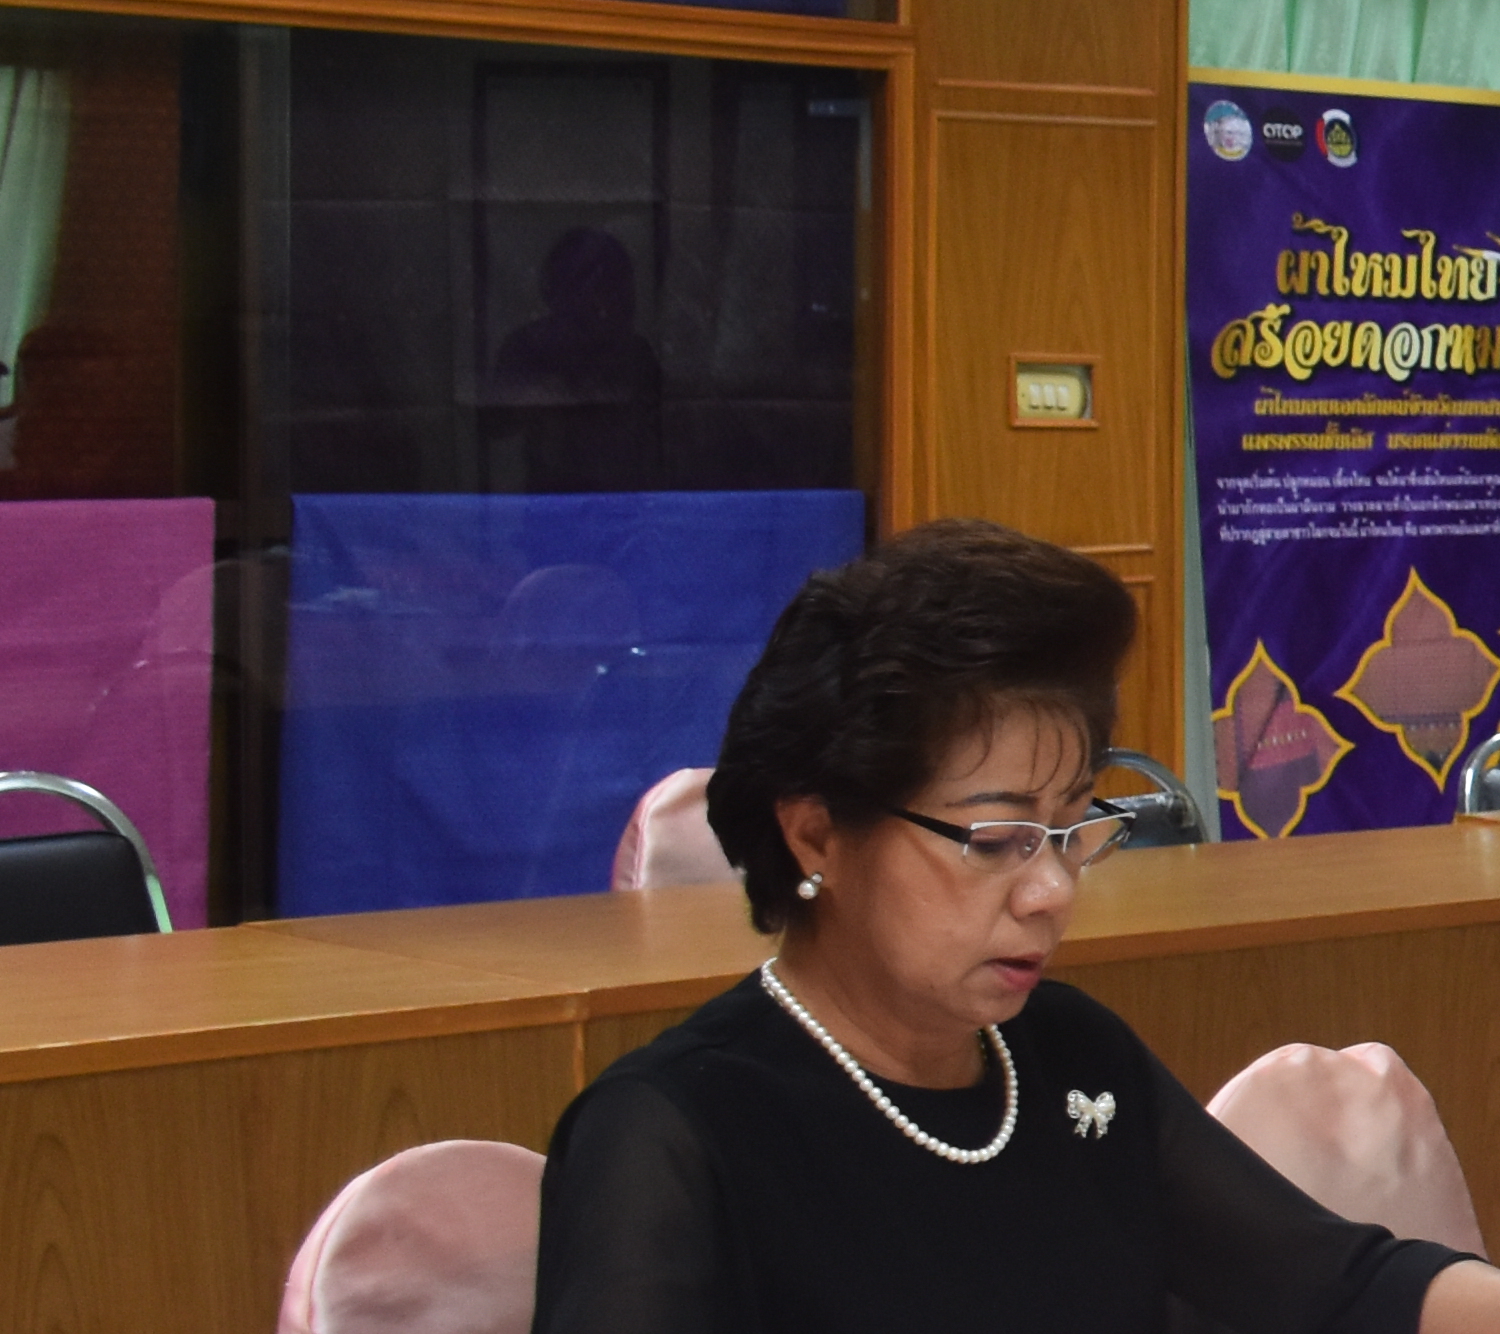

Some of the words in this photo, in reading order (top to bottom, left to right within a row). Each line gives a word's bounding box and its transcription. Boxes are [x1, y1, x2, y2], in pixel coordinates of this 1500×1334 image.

[1263, 122, 1303, 139] OTOP
[1277, 212, 1499, 300] ผ้าไหมไทย
